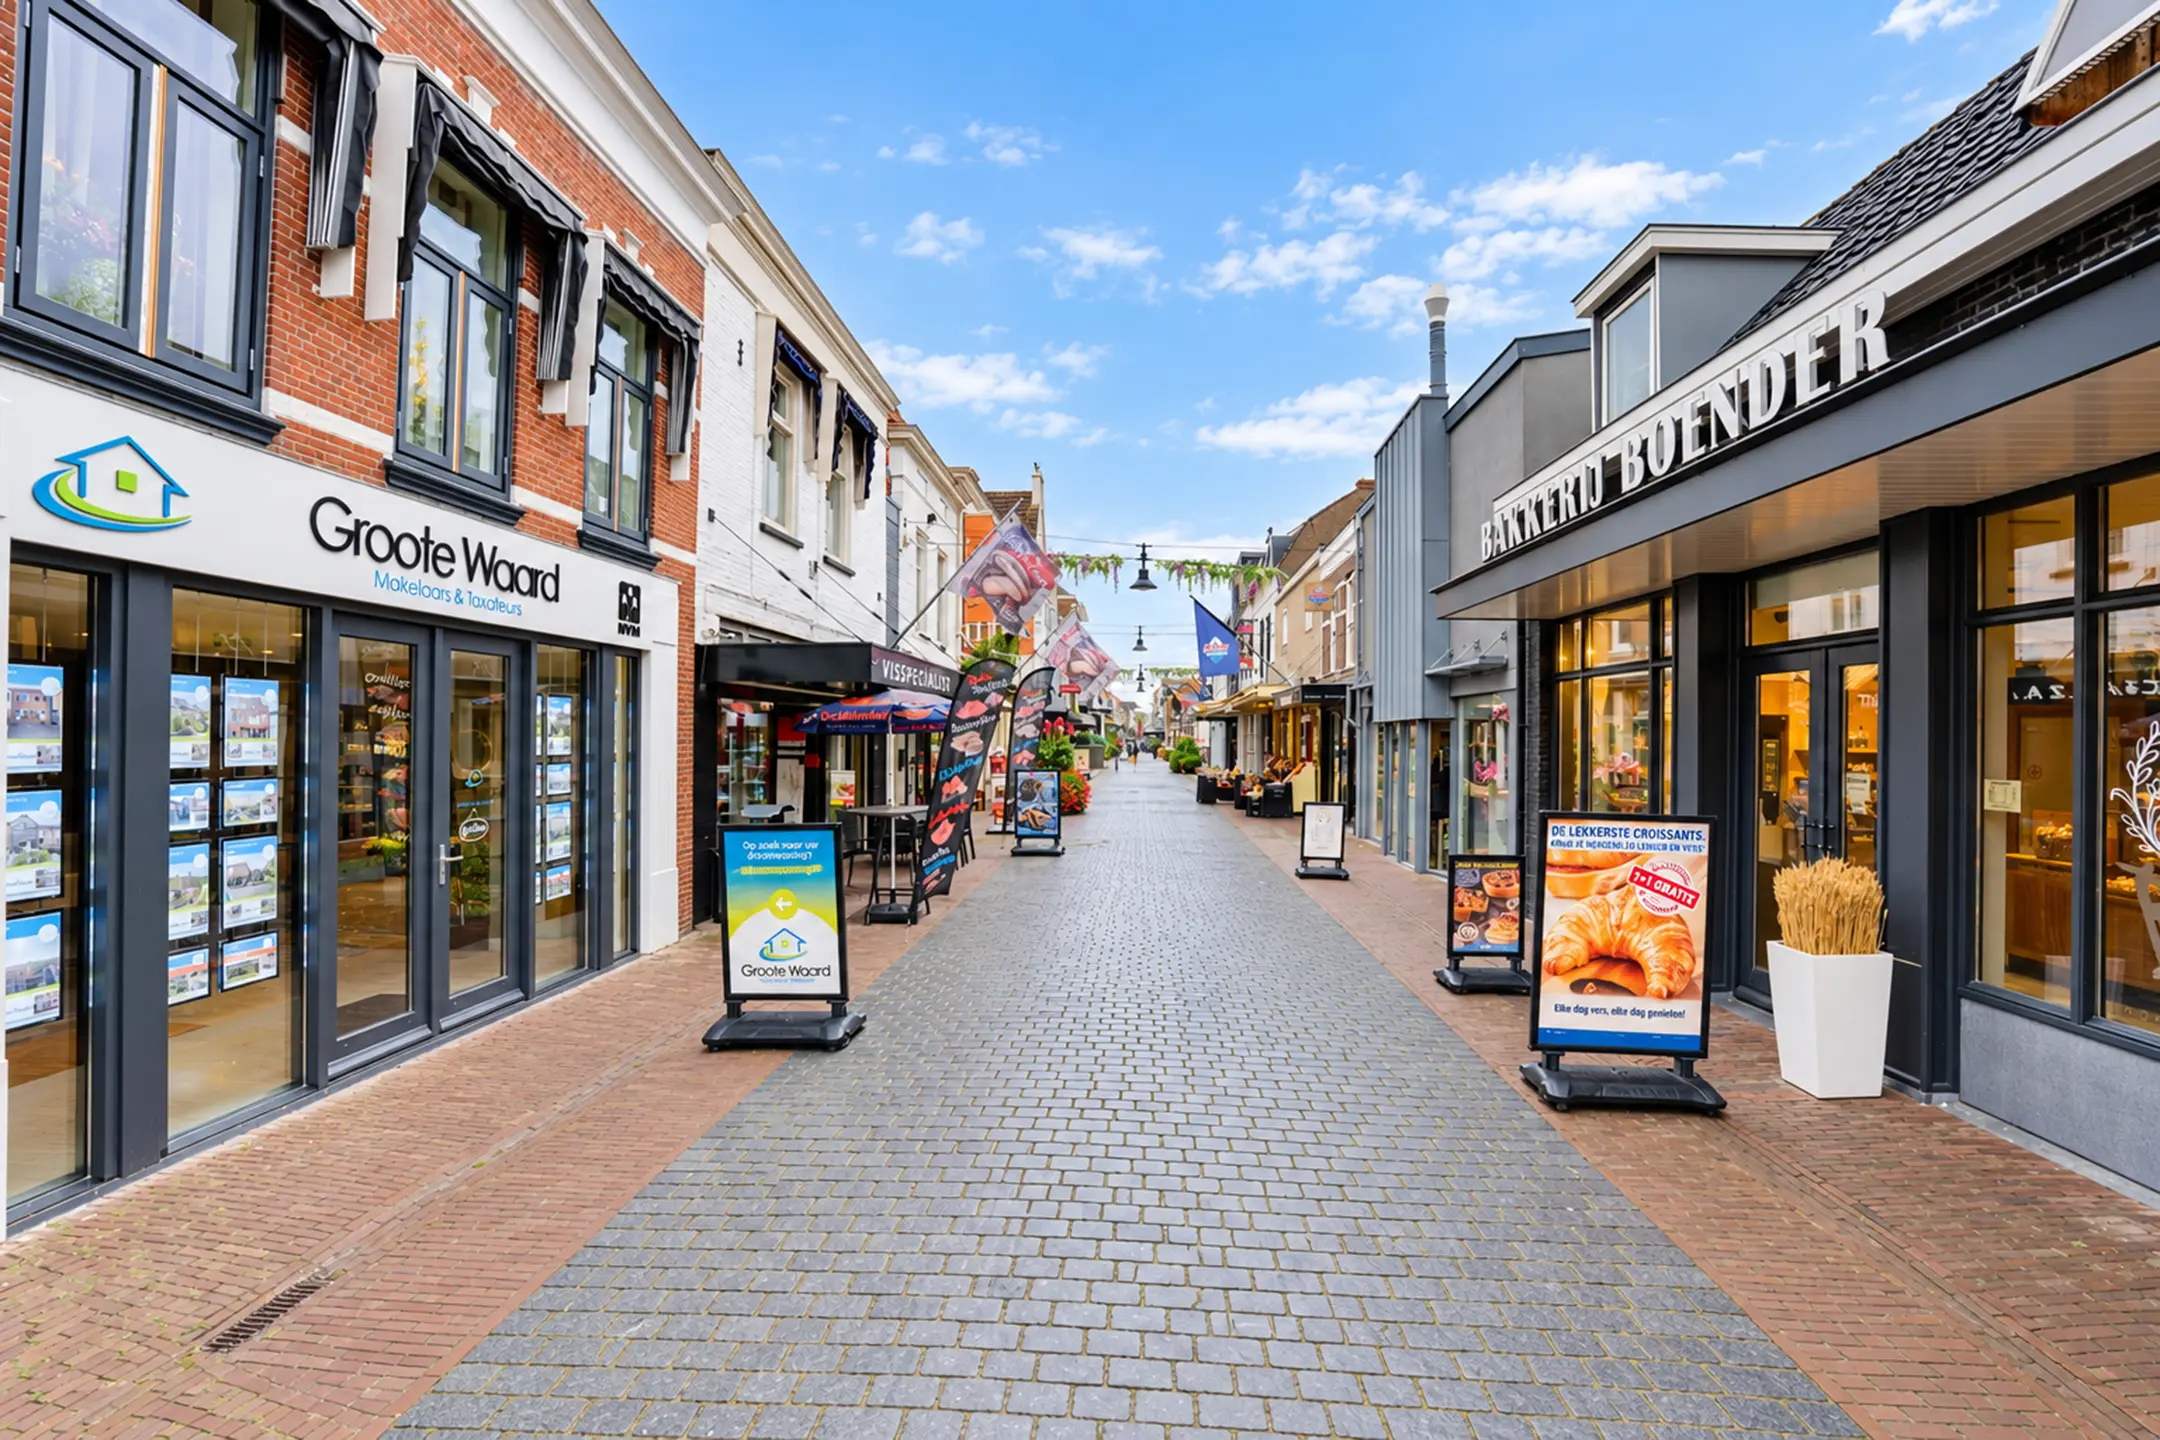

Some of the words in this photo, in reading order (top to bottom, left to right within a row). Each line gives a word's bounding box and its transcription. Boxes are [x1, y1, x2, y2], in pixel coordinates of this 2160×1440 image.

[1481, 452, 1606, 562] BAKKERIJ
[1621, 289, 1890, 494] BOENDER
[309, 496, 456, 579] Groote
[462, 536, 560, 603] Waard
[373, 570, 451, 603] Makelaars
[454, 588, 465, 605] &
[467, 591, 523, 616] Taxateurs
[618, 622, 640, 638] NVM
[1568, 826, 1630, 839] LEKKERSTE
[741, 964, 787, 977] Groote
[788, 964, 831, 977] Waard
